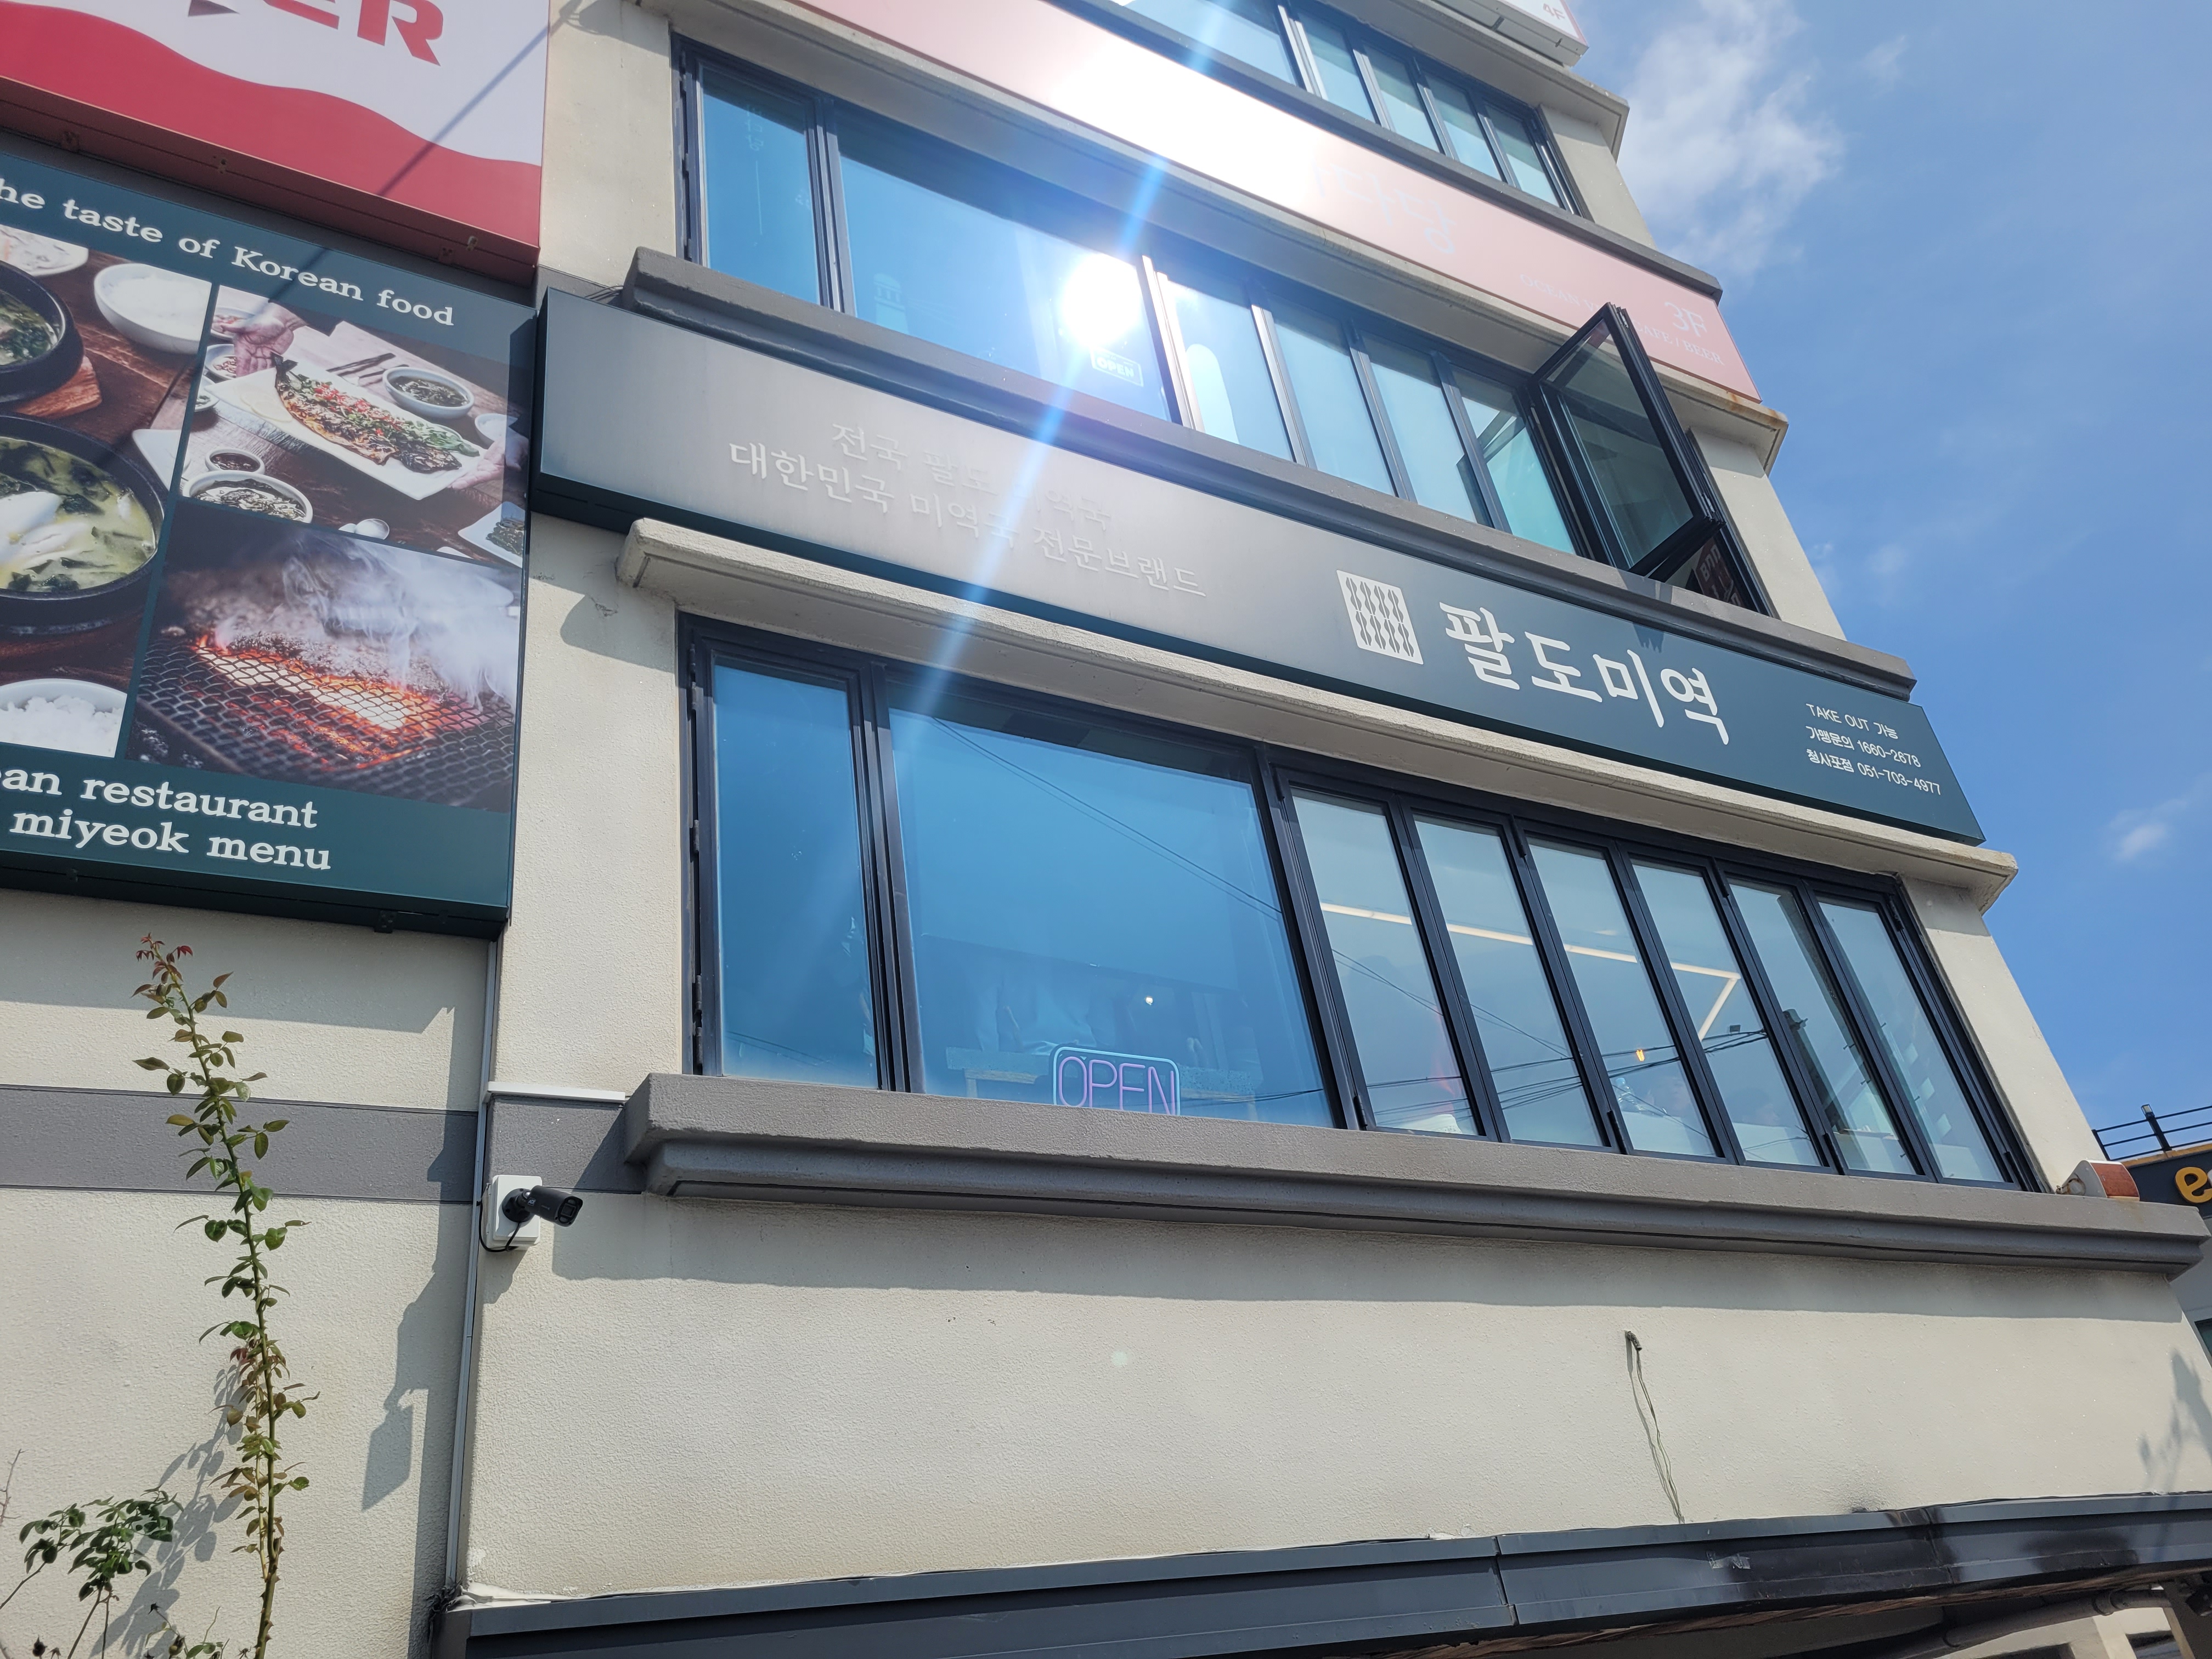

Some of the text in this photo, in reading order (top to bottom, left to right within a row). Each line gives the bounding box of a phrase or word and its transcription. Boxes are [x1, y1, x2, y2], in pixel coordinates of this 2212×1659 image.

[1543, 3, 1565, 20] 4F
[63, 198, 163, 243] taste
[178, 239, 220, 258] of
[231, 246, 363, 300] Korean
[378, 290, 454, 326] food
[1520, 274, 1580, 306] OCEAN
[1632, 319, 1673, 345] CAFE
[1682, 340, 1725, 366] BEER
[1664, 302, 1707, 337] 3F
[1096, 356, 1135, 377] OPEN
[832, 422, 909, 471] 전국
[922, 450, 998, 496] 팔도
[729, 442, 1207, 597] 대한민국 미역국 전문브랜드
[1439, 601, 1729, 745] 팔도미역
[1805, 703, 1899, 740] TAKE OUT 가능
[1805, 725, 1921, 768] 가맹문의 1660-2678
[1806, 748, 1942, 795] 청사포점 051-703-4977
[0, 769, 318, 828] an restaurant
[9, 809, 331, 870] miyeok menu
[1058, 1056, 1176, 1115] OPEN
[2175, 1166, 2212, 1203] e
